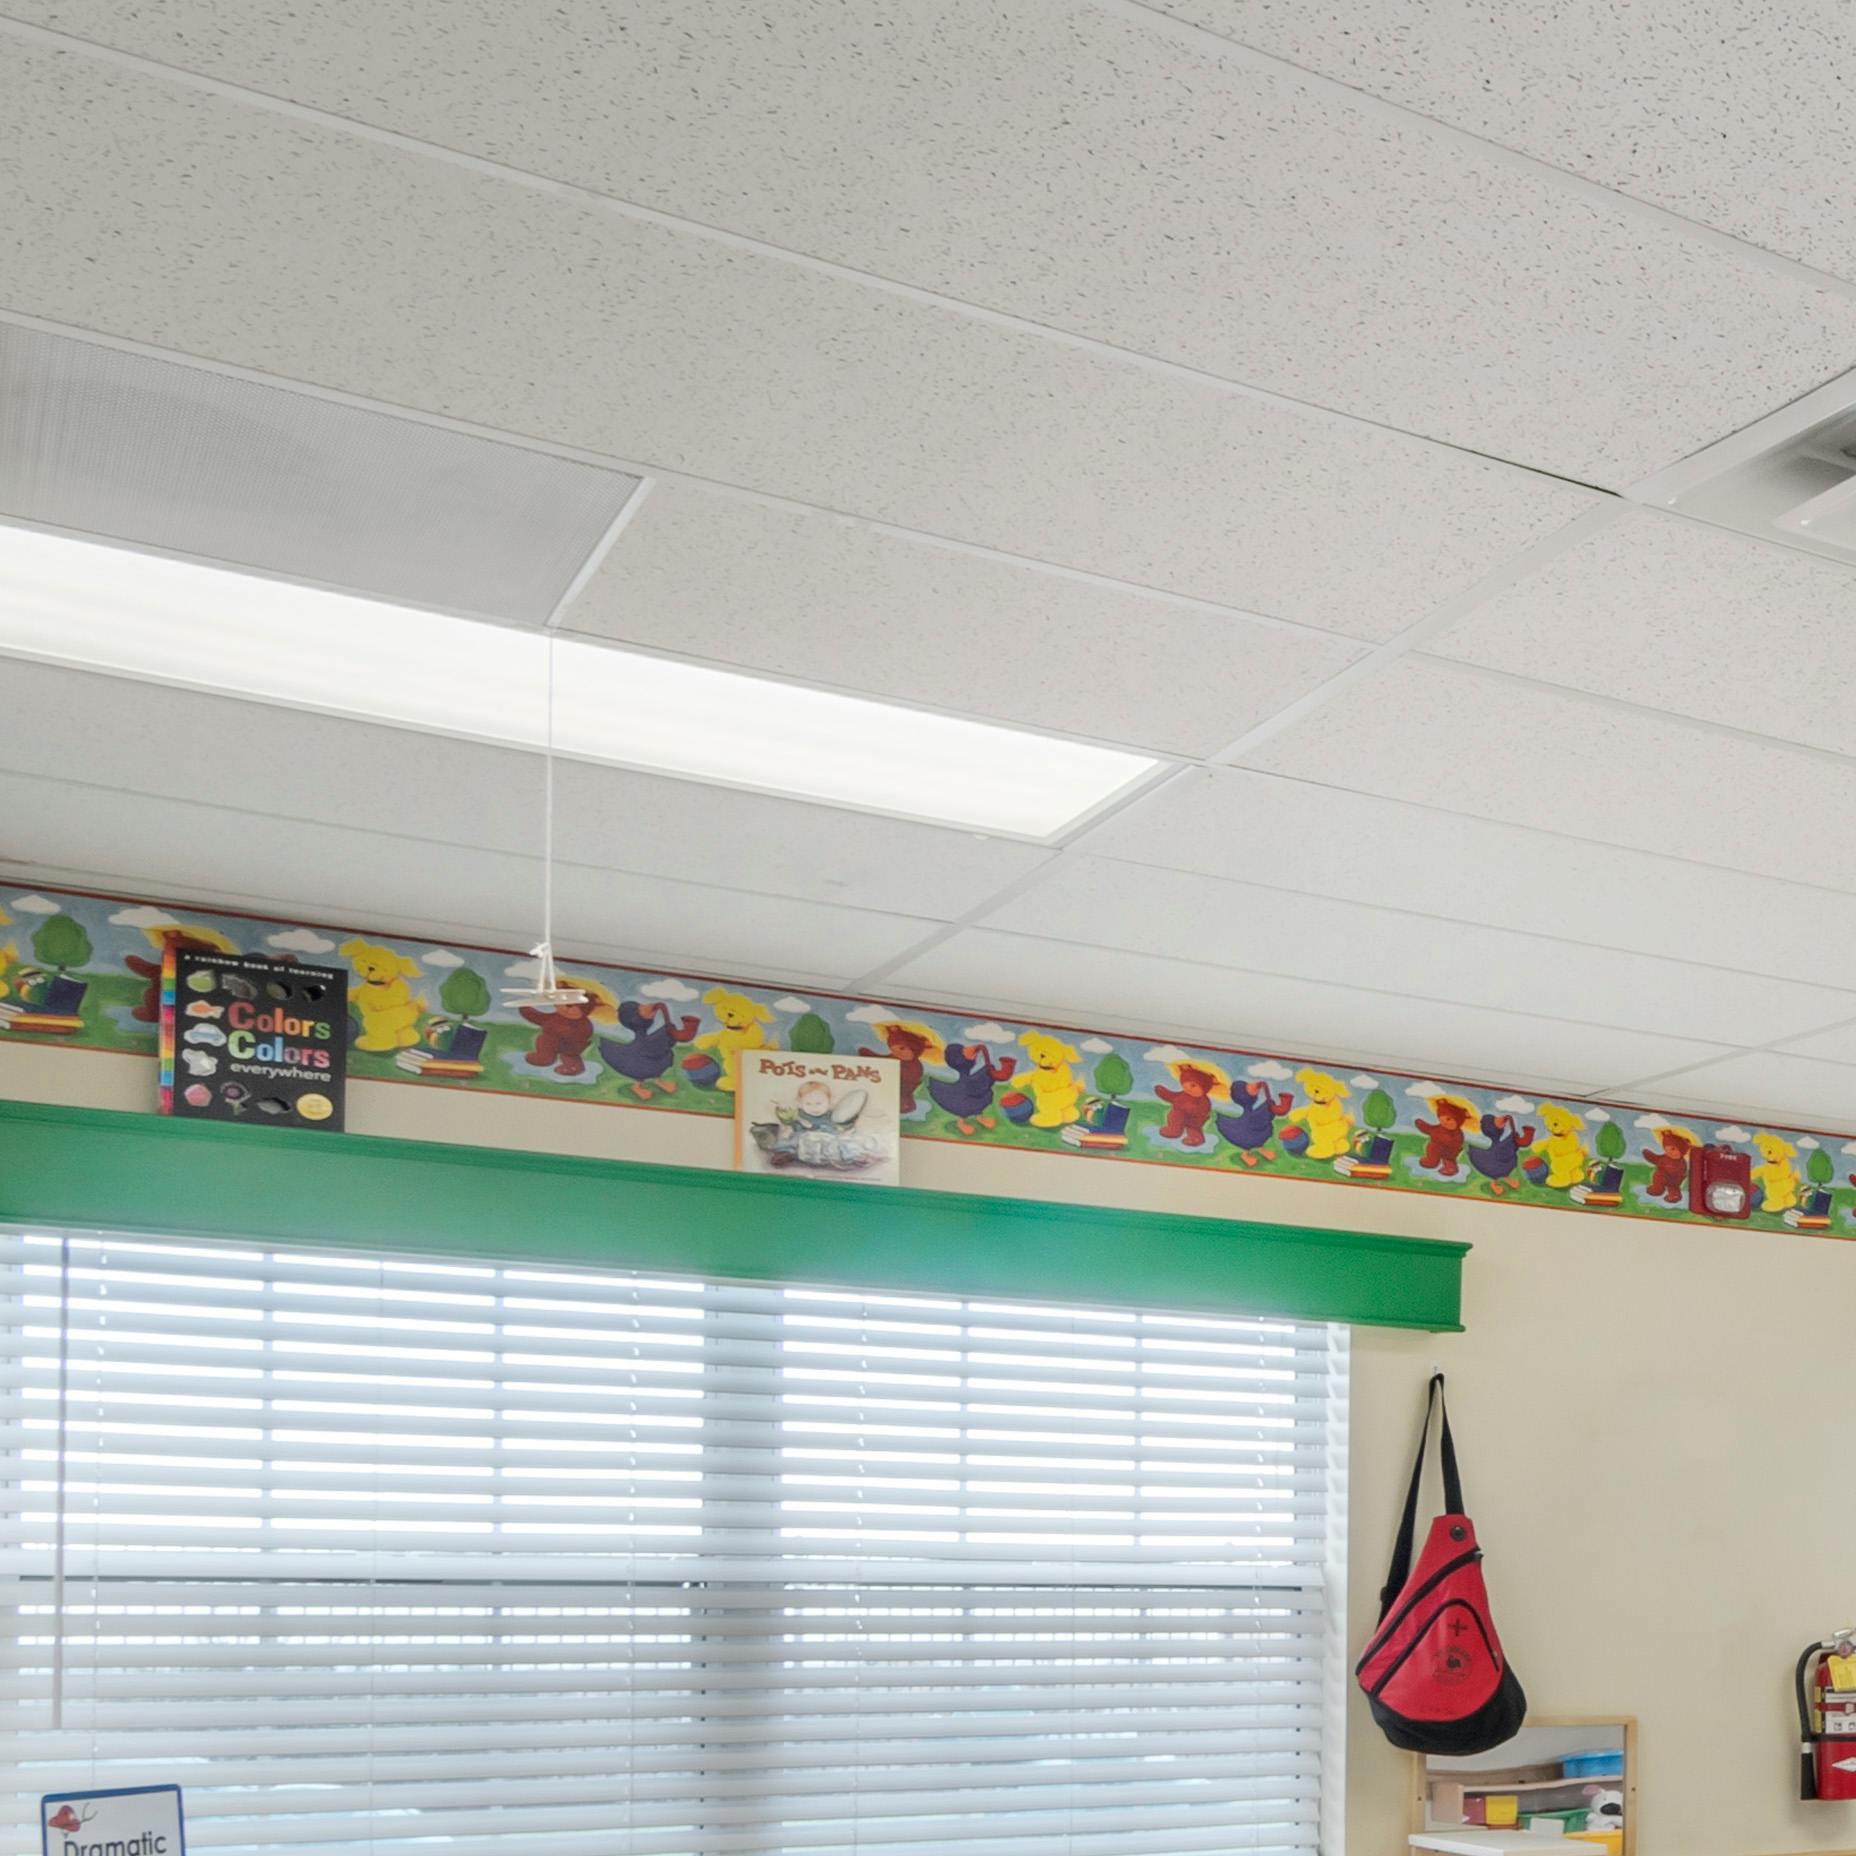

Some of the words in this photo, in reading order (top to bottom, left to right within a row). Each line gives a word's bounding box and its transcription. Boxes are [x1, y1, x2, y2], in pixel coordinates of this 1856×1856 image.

[227, 1001, 331, 1040] Colors
[227, 1030, 331, 1068] Colors
[230, 1062, 332, 1082] everywhere
